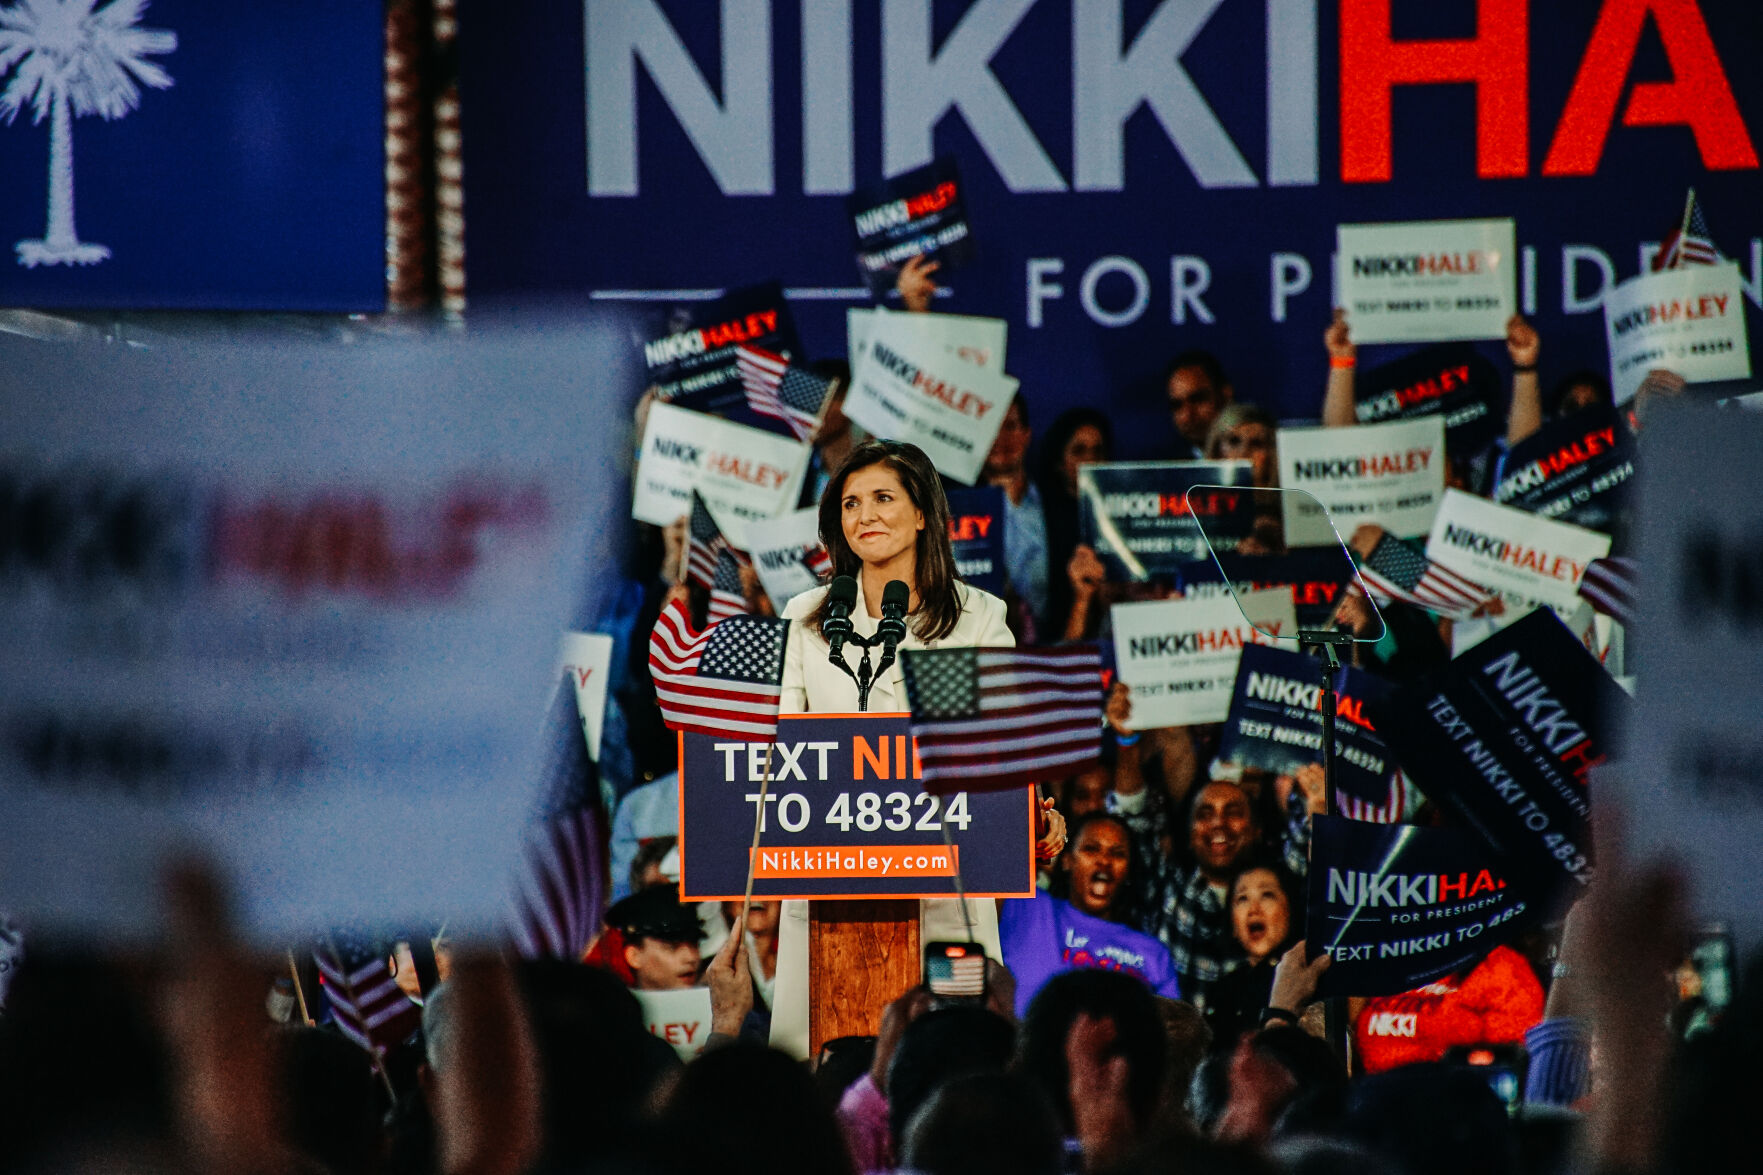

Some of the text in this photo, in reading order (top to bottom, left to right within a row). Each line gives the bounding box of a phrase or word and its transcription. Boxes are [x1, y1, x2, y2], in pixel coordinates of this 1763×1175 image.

[1026, 255, 1216, 328] FOR
[652, 436, 790, 490] NIKKHALEY
[1295, 446, 1433, 480] NIKKIHALEY
[1239, 717, 1272, 740] TEXT
[1272, 725, 1323, 750] NIKKI
[1482, 651, 1607, 785] NIKKIH
[714, 735, 923, 782] TEXT NI
[1427, 693, 1475, 742] TEXT
[1463, 739, 1527, 805] NIKKI
[1518, 801, 1551, 833] TO
[745, 791, 972, 832] TO 48324
[762, 852, 948, 874] NikkiHaley.com
[1327, 867, 1507, 908] NIKKIHA
[1391, 893, 1504, 925] FOR PRESIDENT
[1323, 944, 1375, 962] TEXT
[1380, 932, 1451, 958] NIKKI
[1456, 922, 1484, 942] TO
